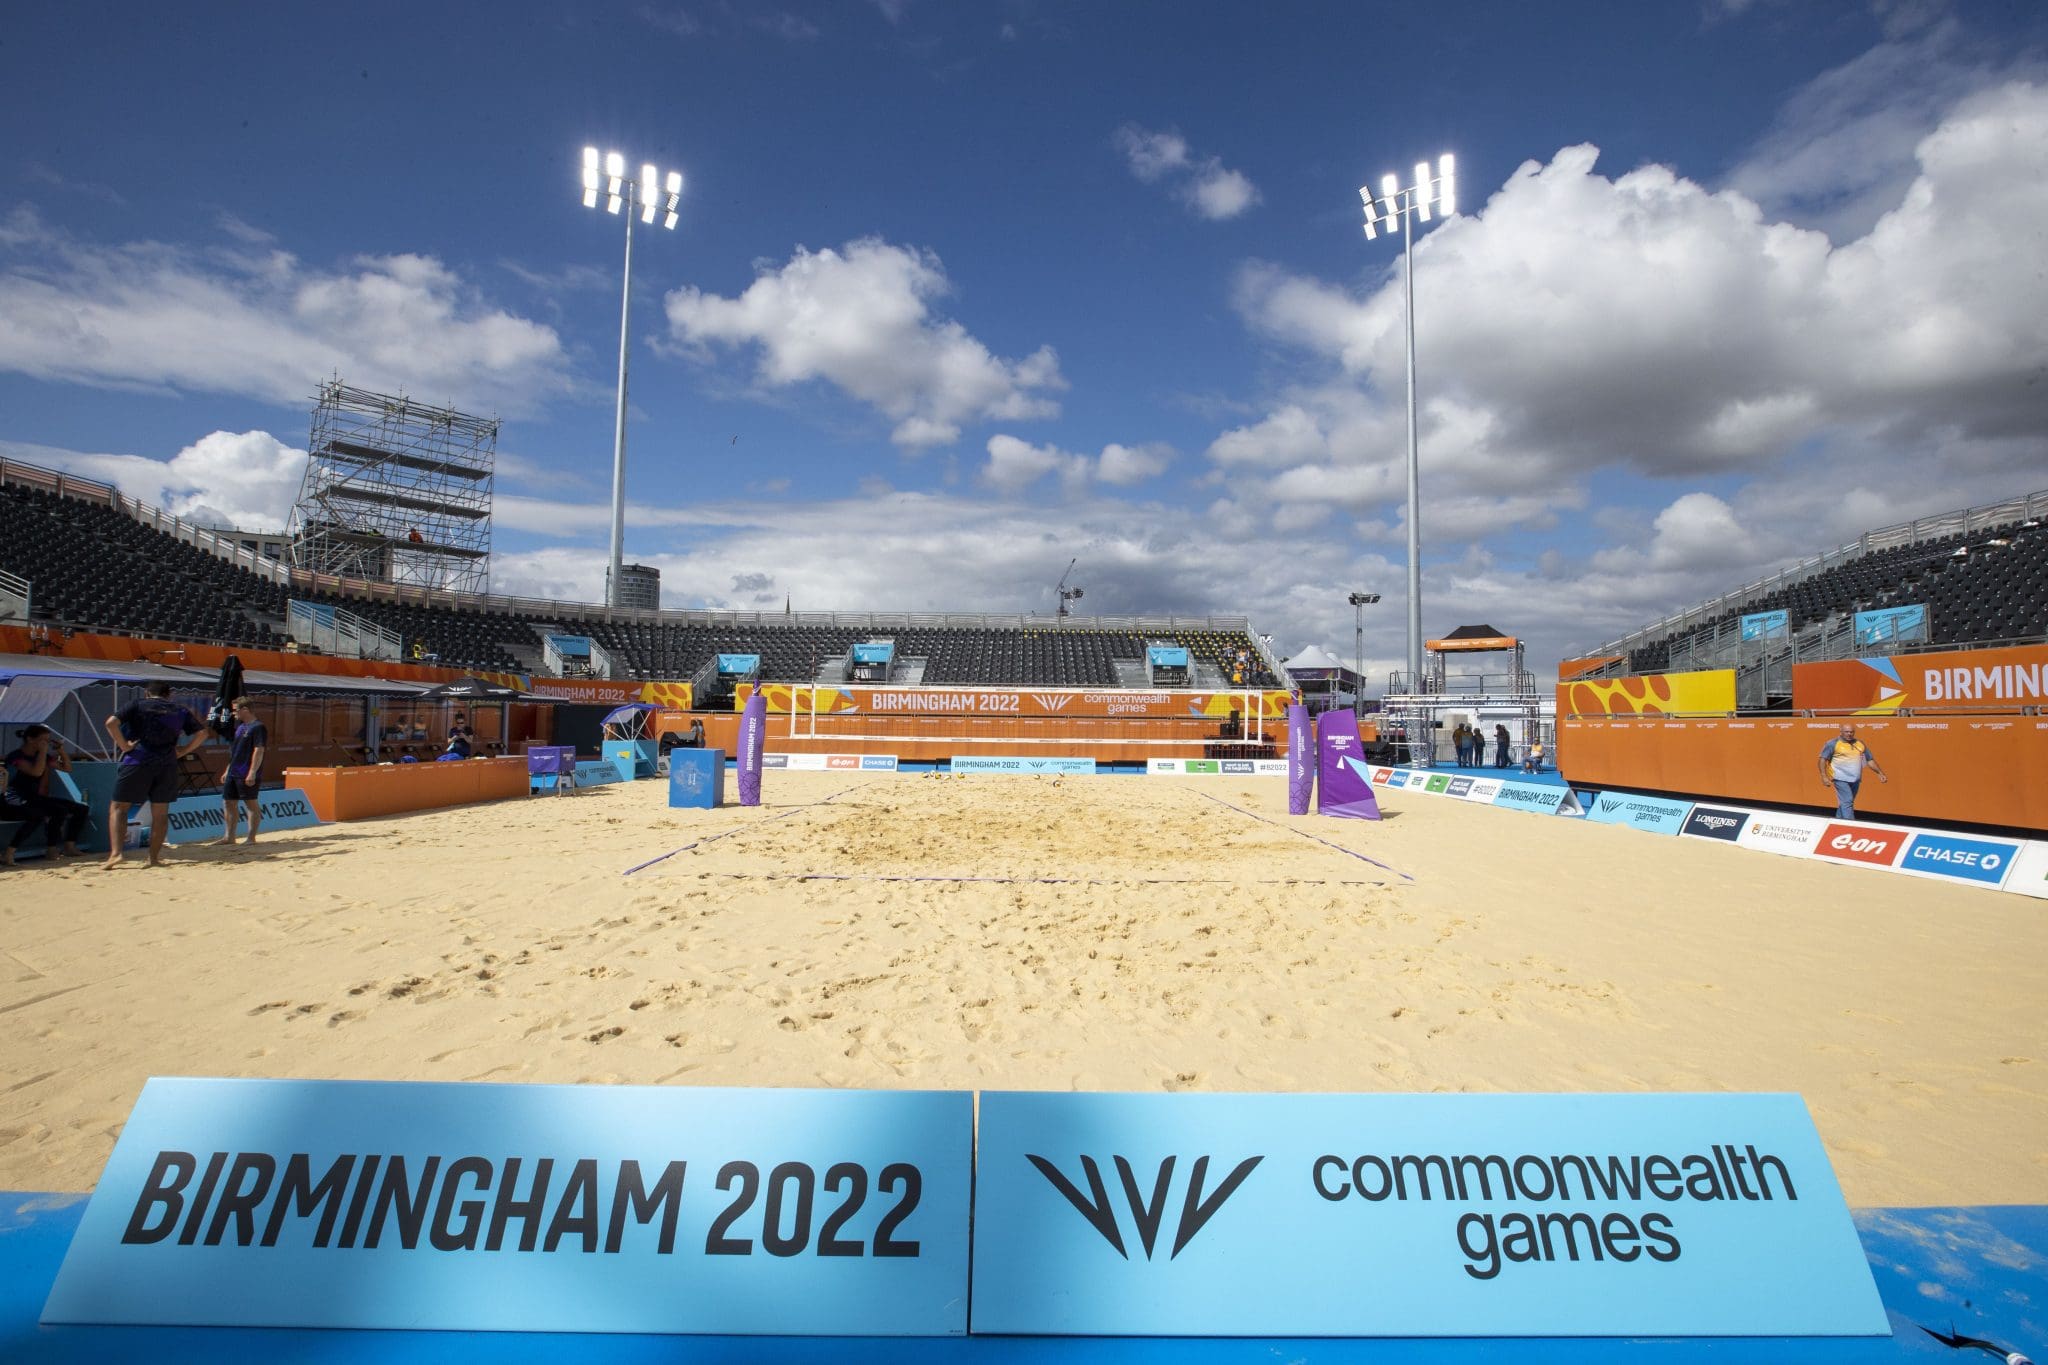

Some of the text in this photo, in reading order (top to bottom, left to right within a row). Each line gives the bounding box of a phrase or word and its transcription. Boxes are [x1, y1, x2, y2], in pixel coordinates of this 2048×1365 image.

[534, 685, 625, 701] BIRMINGHAM 2022
[1084, 692, 1171, 704] commonwealth
[872, 693, 1020, 711] BIRMINGHAM 2022
[1107, 703, 1147, 715] games
[746, 717, 757, 771] BIRMINGHAM 2022
[954, 761, 1020, 769] BIRMINGHAM 2022
[1498, 788, 1560, 806] BIRMINGHAM 2022
[168, 800, 309, 830] BIRMINHM 2022
[1626, 802, 1683, 818] commonwealth
[1635, 811, 1662, 823] games
[1695, 814, 1738, 827] LONGINES
[1762, 831, 1808, 843] BIRMINGHAM
[1765, 825, 1805, 836] UNIVERSITY
[1913, 846, 1980, 866] CHASE
[1312, 1144, 1798, 1202] commonwealth
[122, 1151, 923, 1258] BIRMINGHAM 2022
[1456, 1210, 1682, 1280] games
